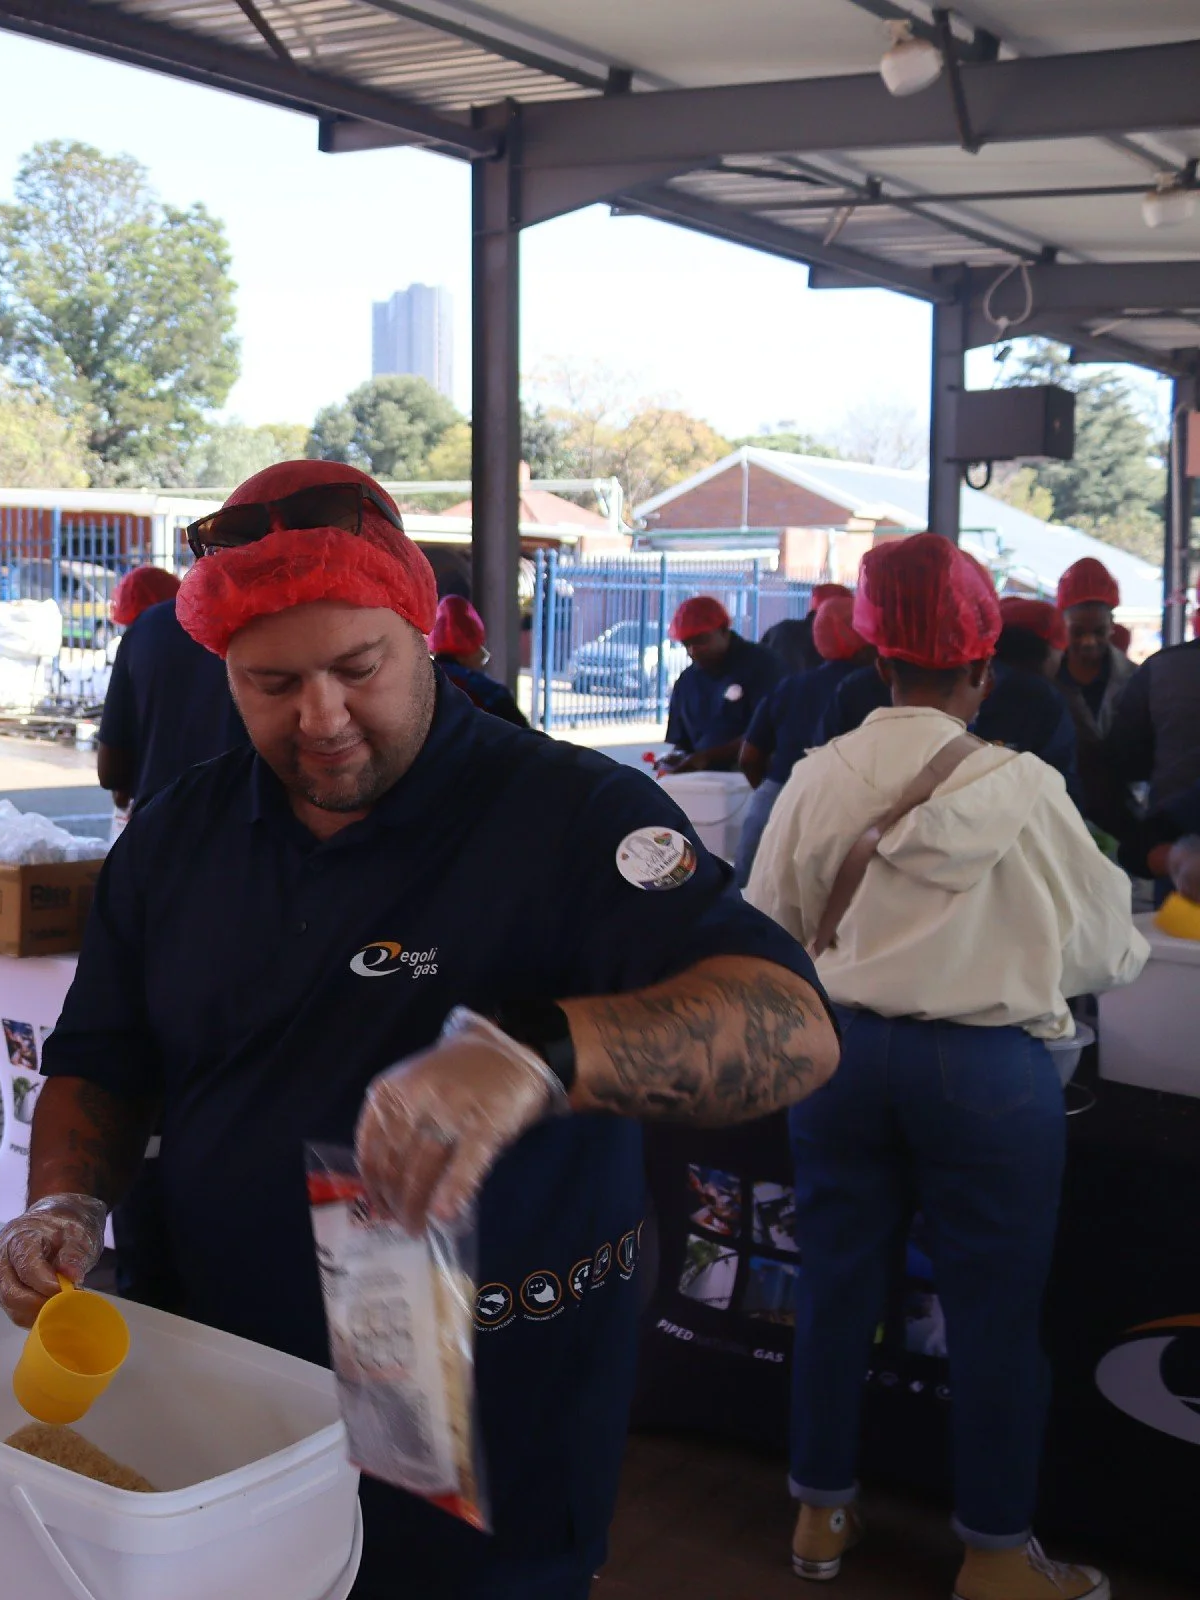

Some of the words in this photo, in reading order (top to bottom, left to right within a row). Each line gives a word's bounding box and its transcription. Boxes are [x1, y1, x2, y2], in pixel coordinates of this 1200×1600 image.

[400, 947, 438, 966] egoli
[412, 964, 438, 979] gas
[523, 1305, 565, 1321] COMMUNICATION
[656, 1318, 695, 1341] PIPED
[752, 1348, 786, 1363] GAS
